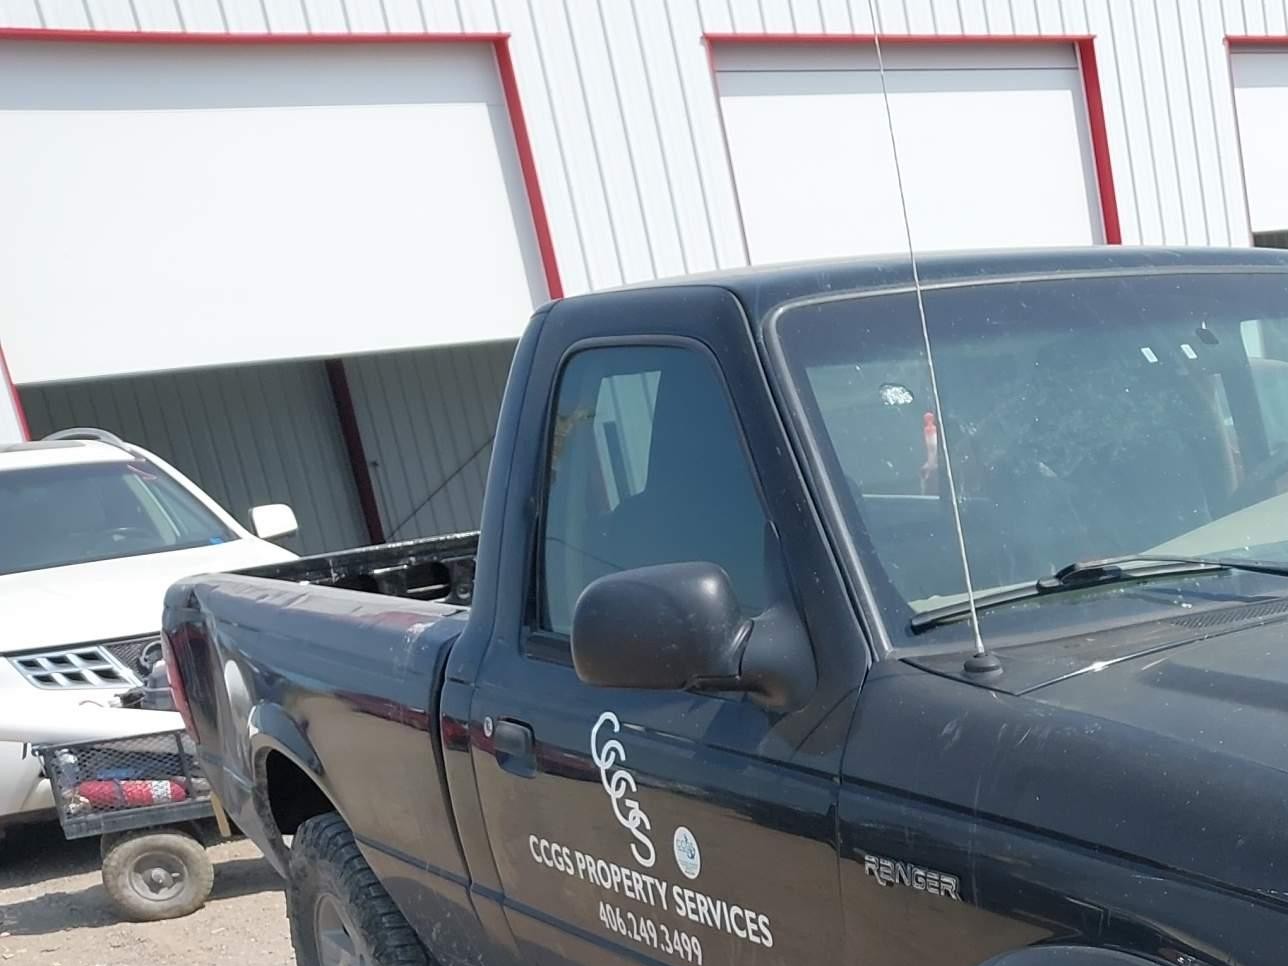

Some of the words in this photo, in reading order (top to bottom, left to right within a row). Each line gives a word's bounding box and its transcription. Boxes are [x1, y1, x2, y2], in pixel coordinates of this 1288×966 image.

[528, 834, 575, 876] CCGS
[576, 850, 668, 911] PROPERTY
[672, 885, 774, 948] SERVICES
[864, 854, 962, 902] RANGER
[599, 901, 703, 966] 406.249.3499
